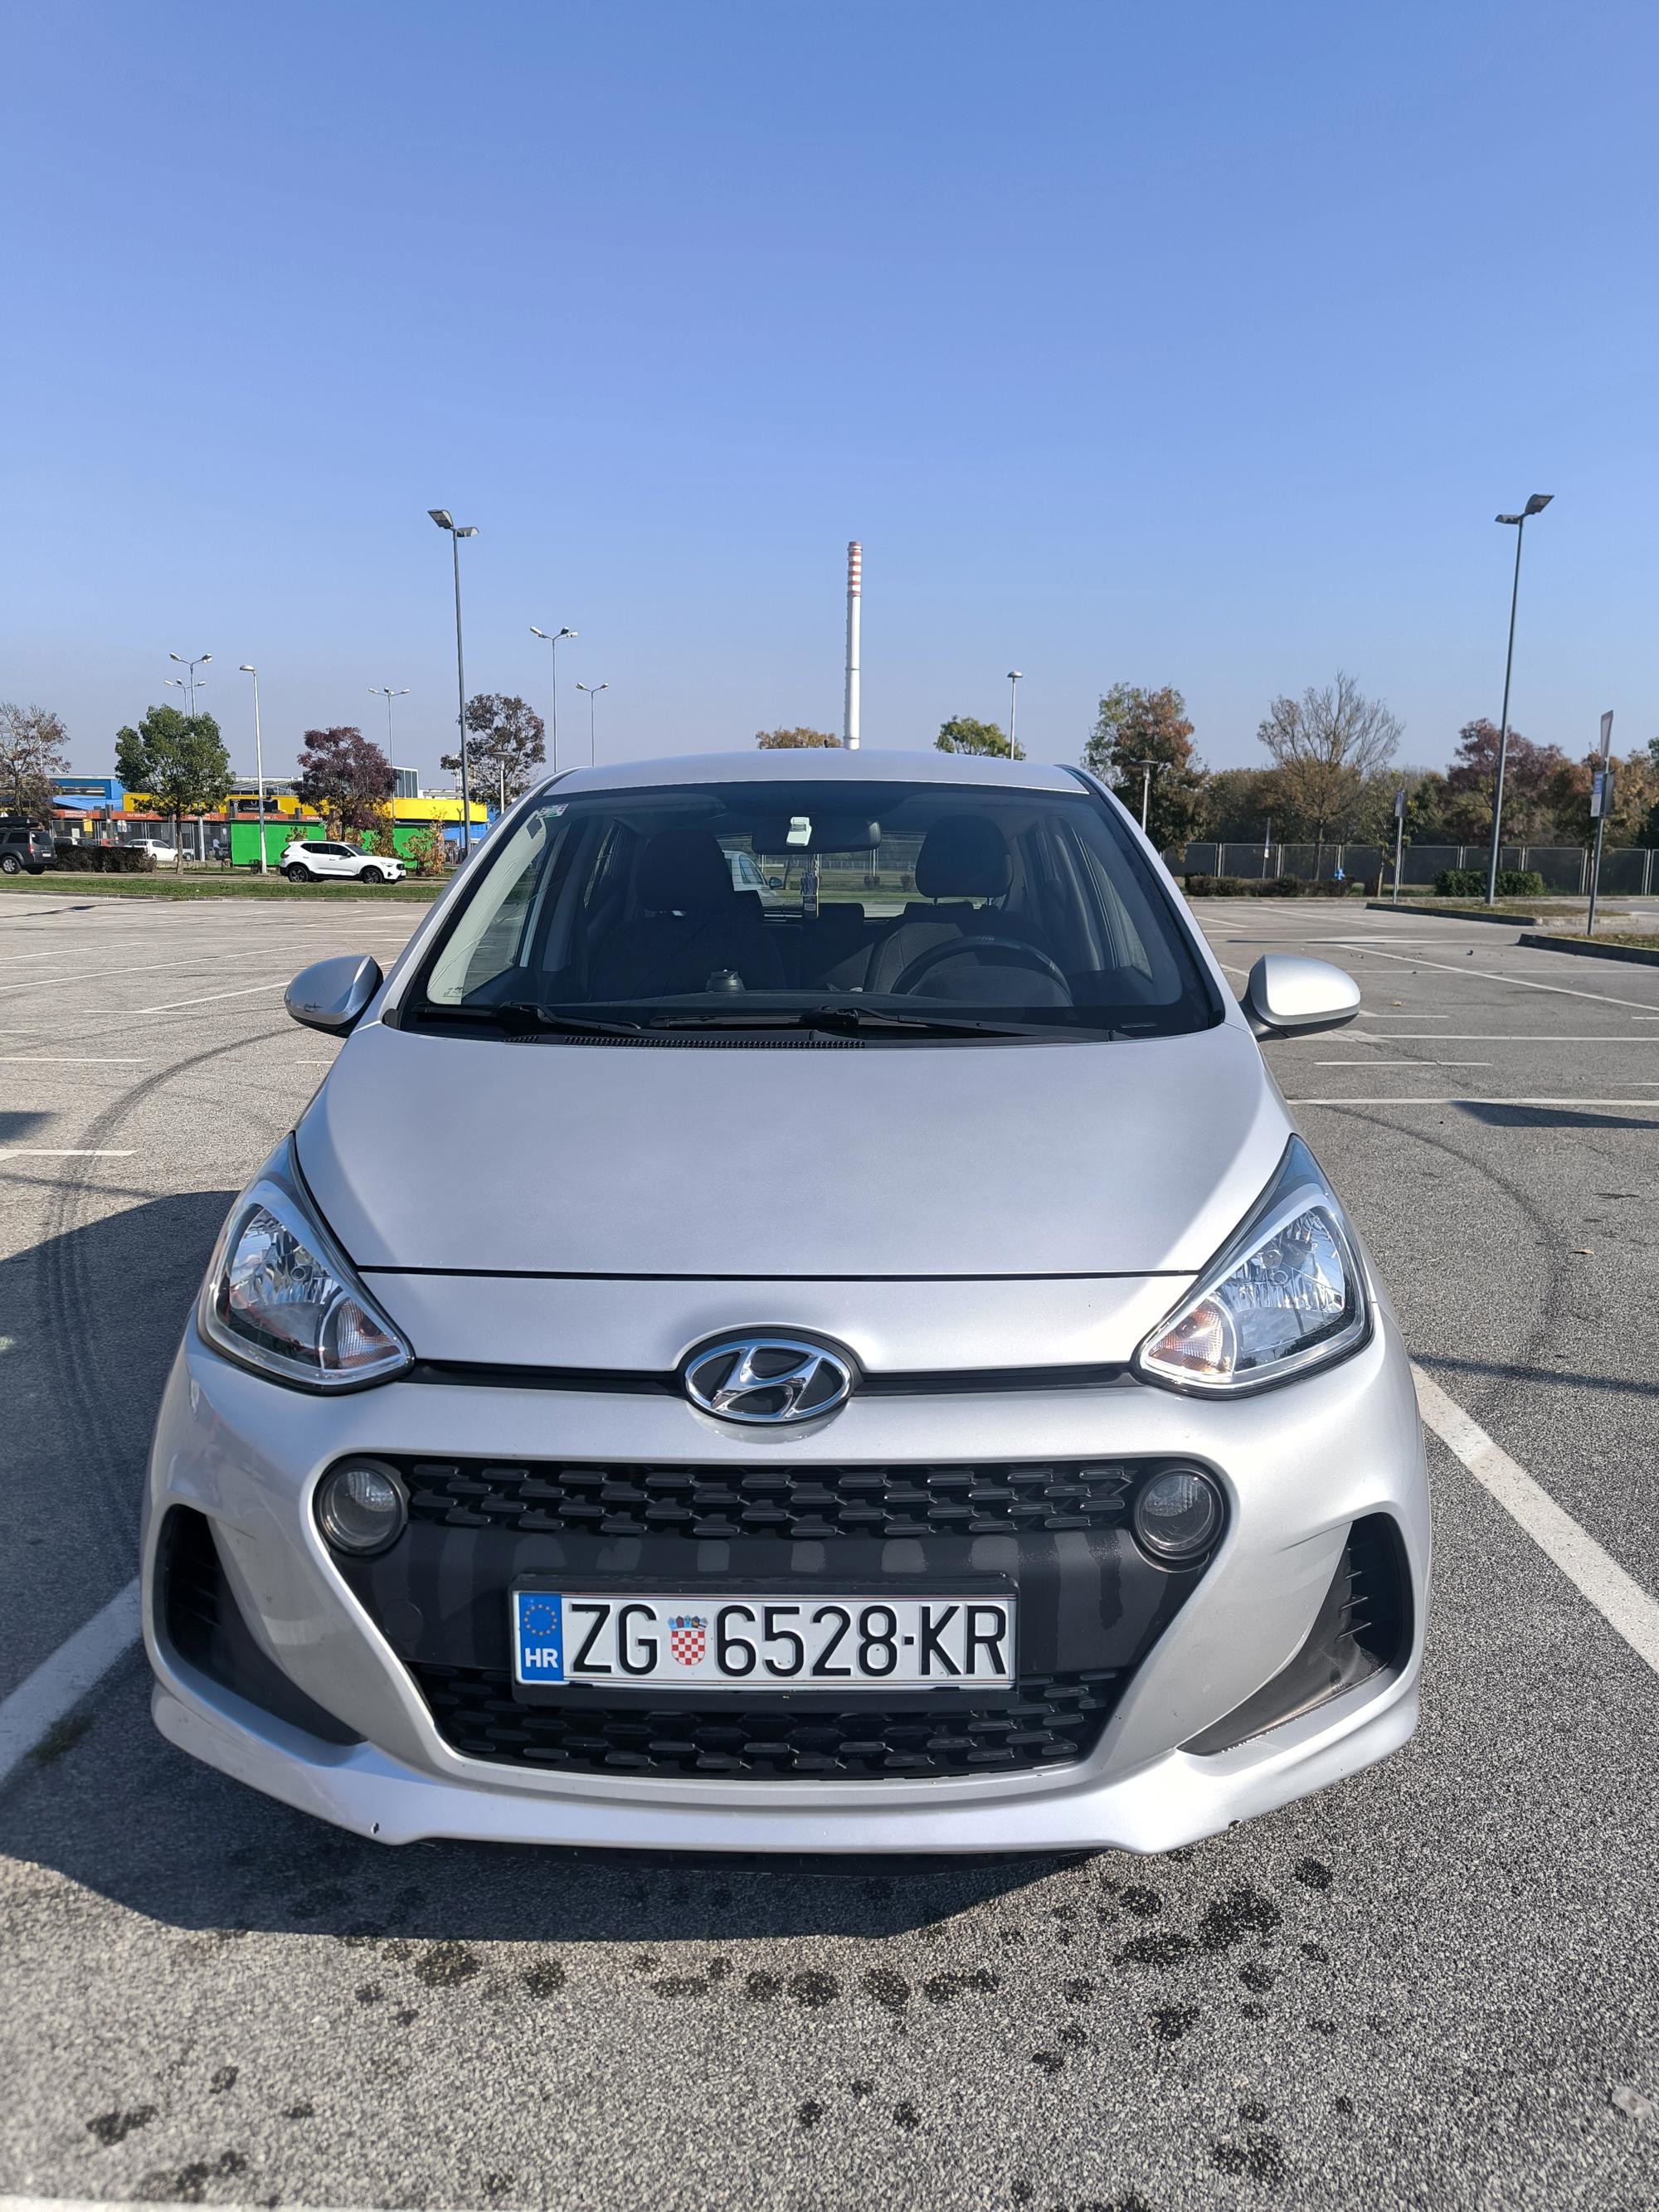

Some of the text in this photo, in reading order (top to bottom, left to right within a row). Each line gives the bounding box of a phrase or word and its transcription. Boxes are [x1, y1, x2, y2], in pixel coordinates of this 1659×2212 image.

[524, 1647, 558, 1669] HR
[571, 1603, 1007, 1677] ZG 6528-KR
